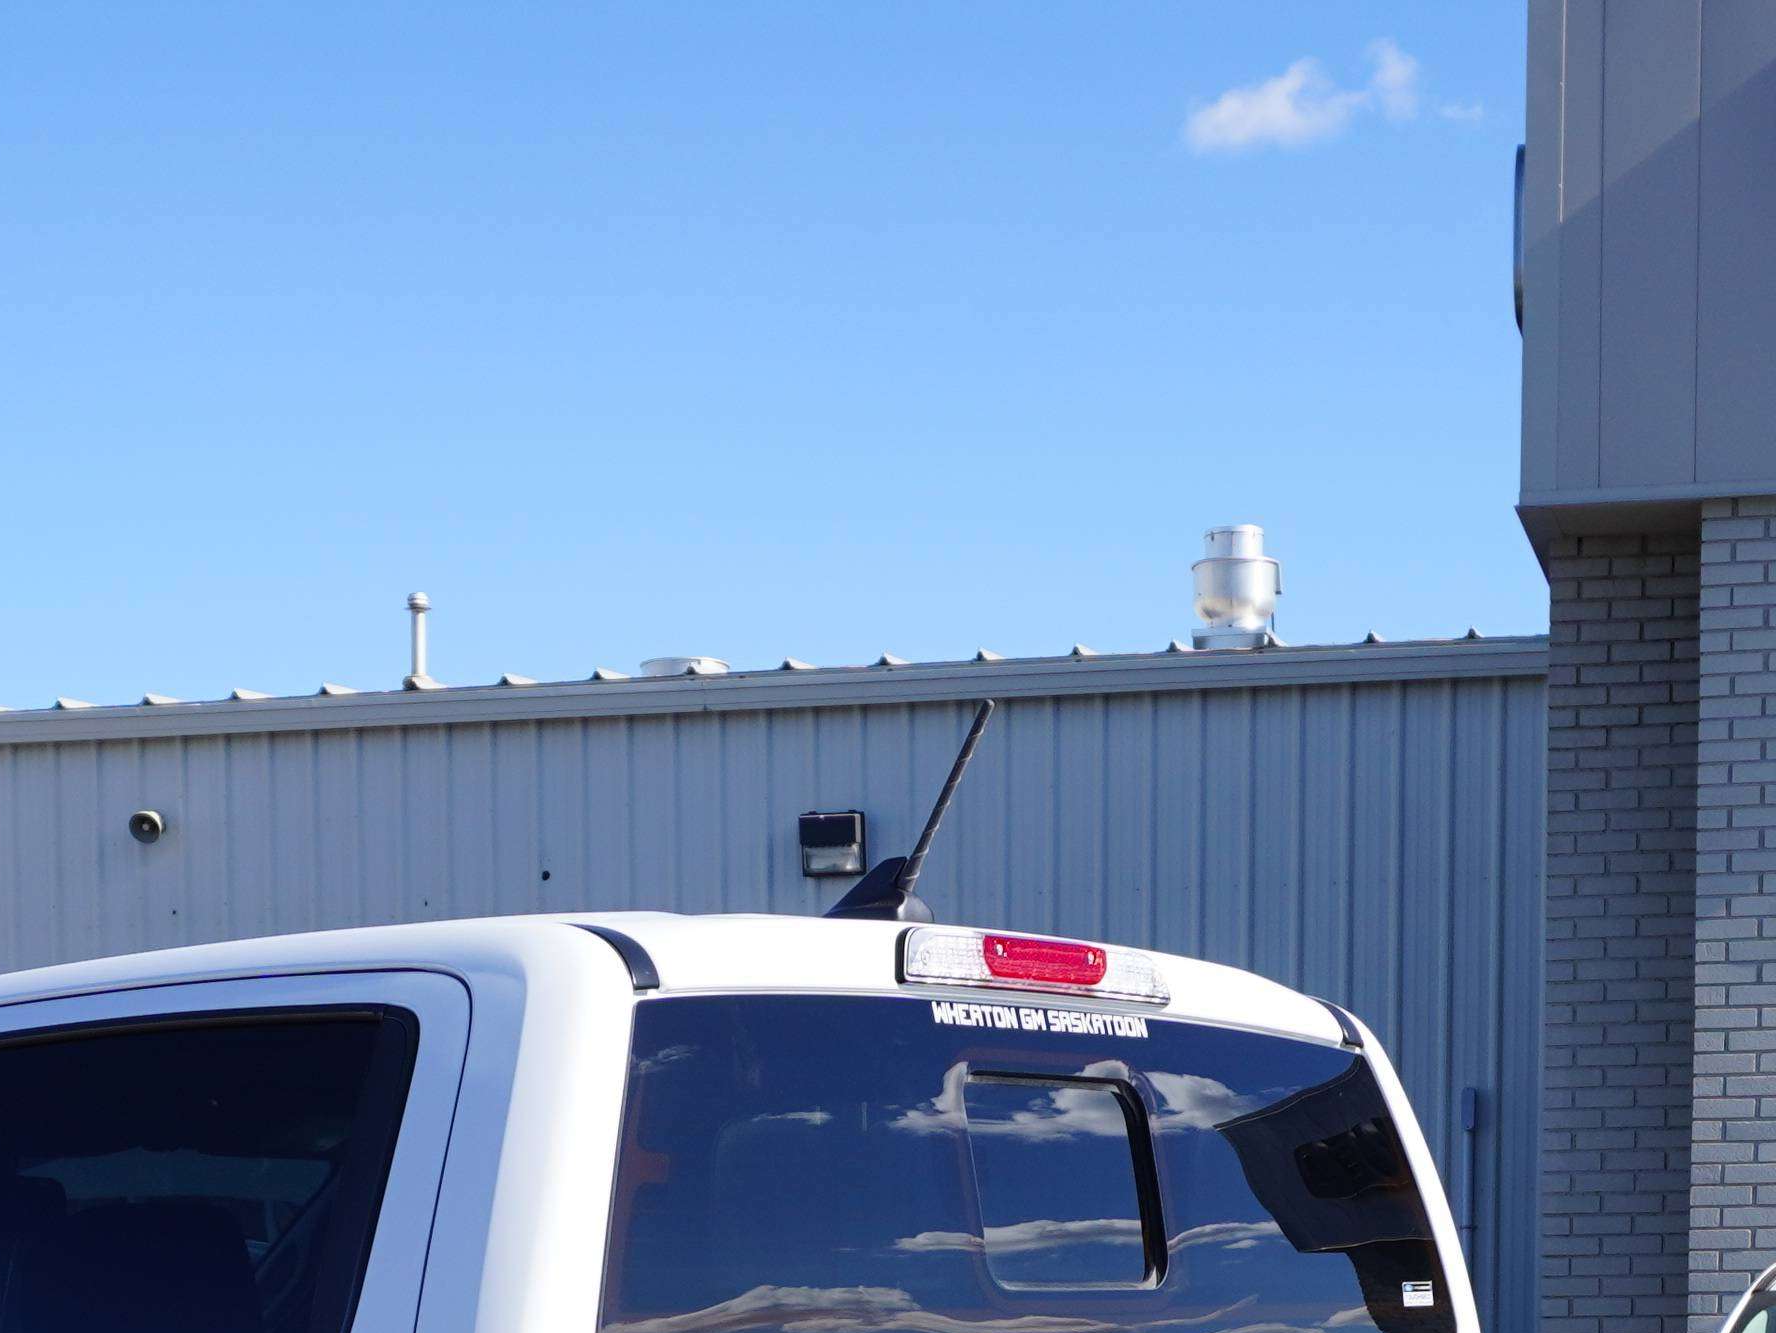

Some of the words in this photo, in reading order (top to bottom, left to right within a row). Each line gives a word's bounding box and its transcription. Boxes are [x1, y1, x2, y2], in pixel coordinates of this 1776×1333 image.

[931, 1001, 1018, 1029] WHEATON
[1019, 1008, 1047, 1031] GM
[1048, 1011, 1149, 1038] SASKATOON
